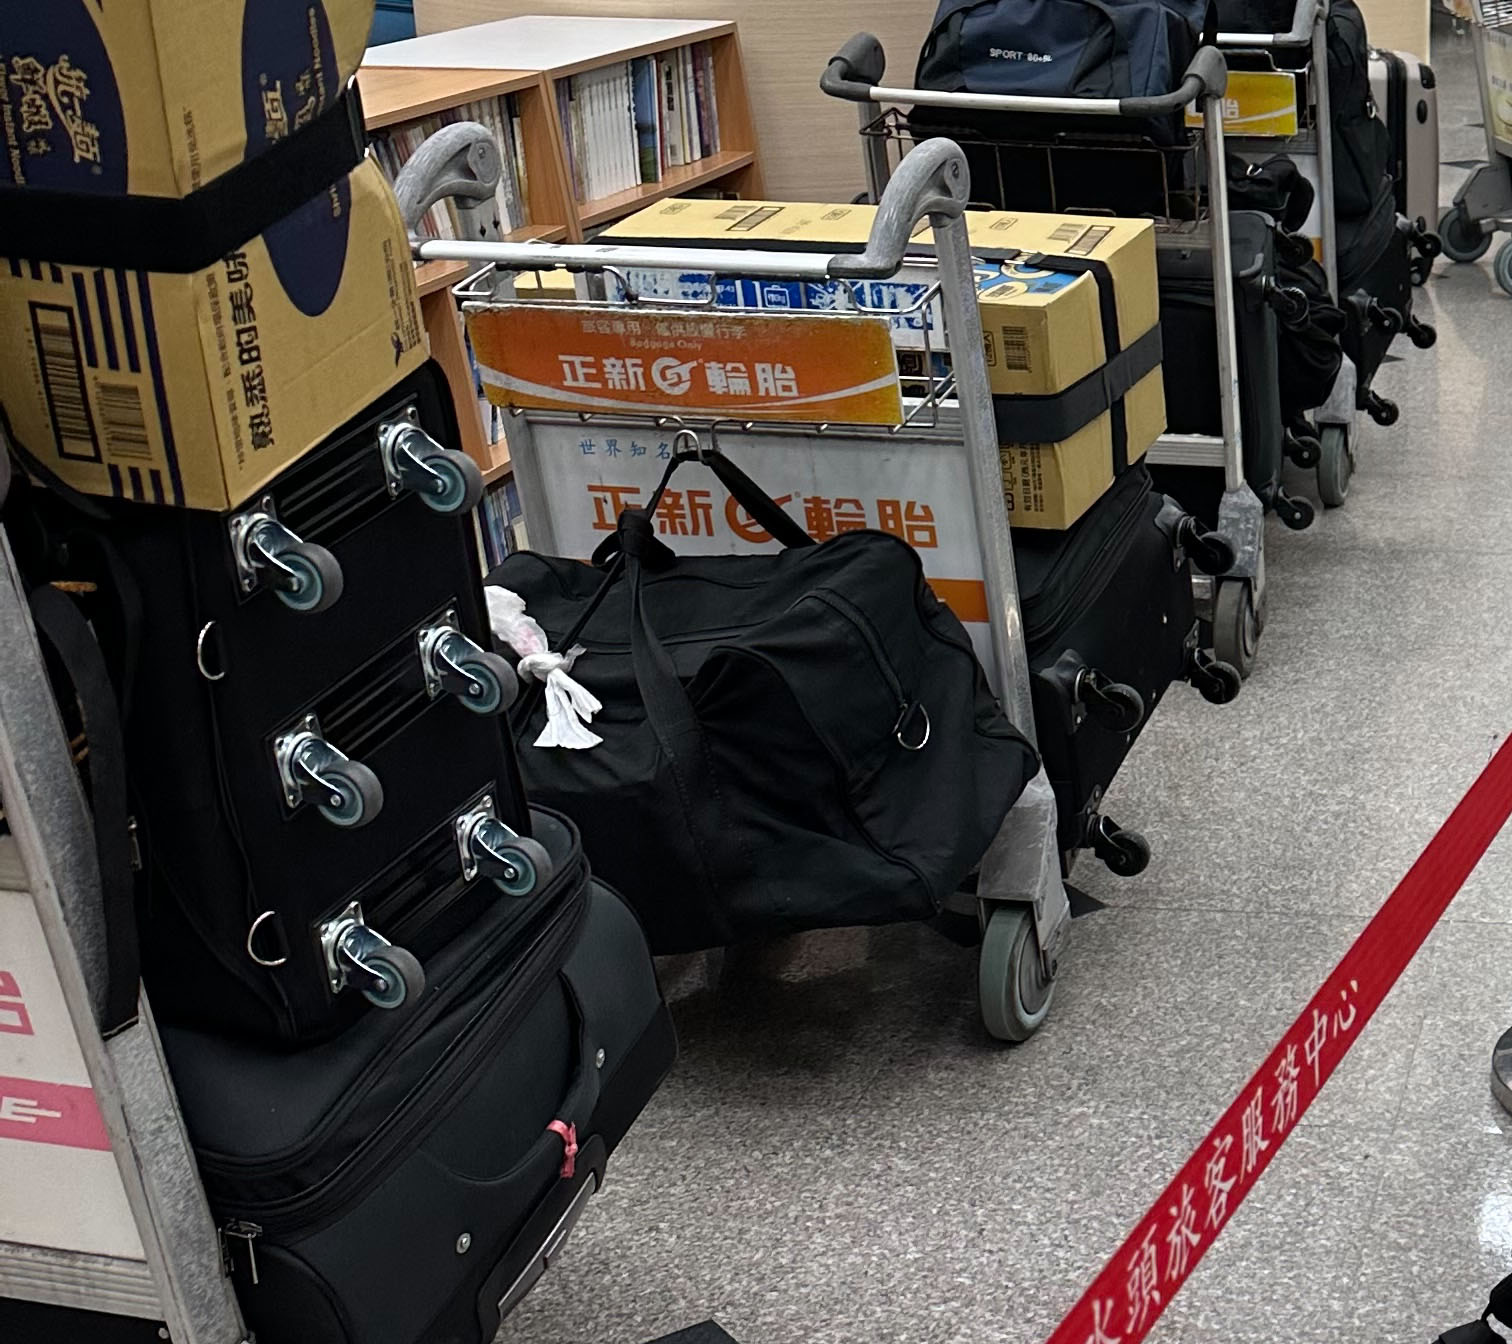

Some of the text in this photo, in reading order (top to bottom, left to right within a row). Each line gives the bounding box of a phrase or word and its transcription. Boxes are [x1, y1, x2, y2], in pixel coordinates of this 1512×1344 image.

[989, 47, 1024, 61] SPORT
[562, 355, 799, 397] 正新 輪胎
[579, 440, 671, 460] 世界知名
[587, 484, 939, 549] 正新 輪胎
